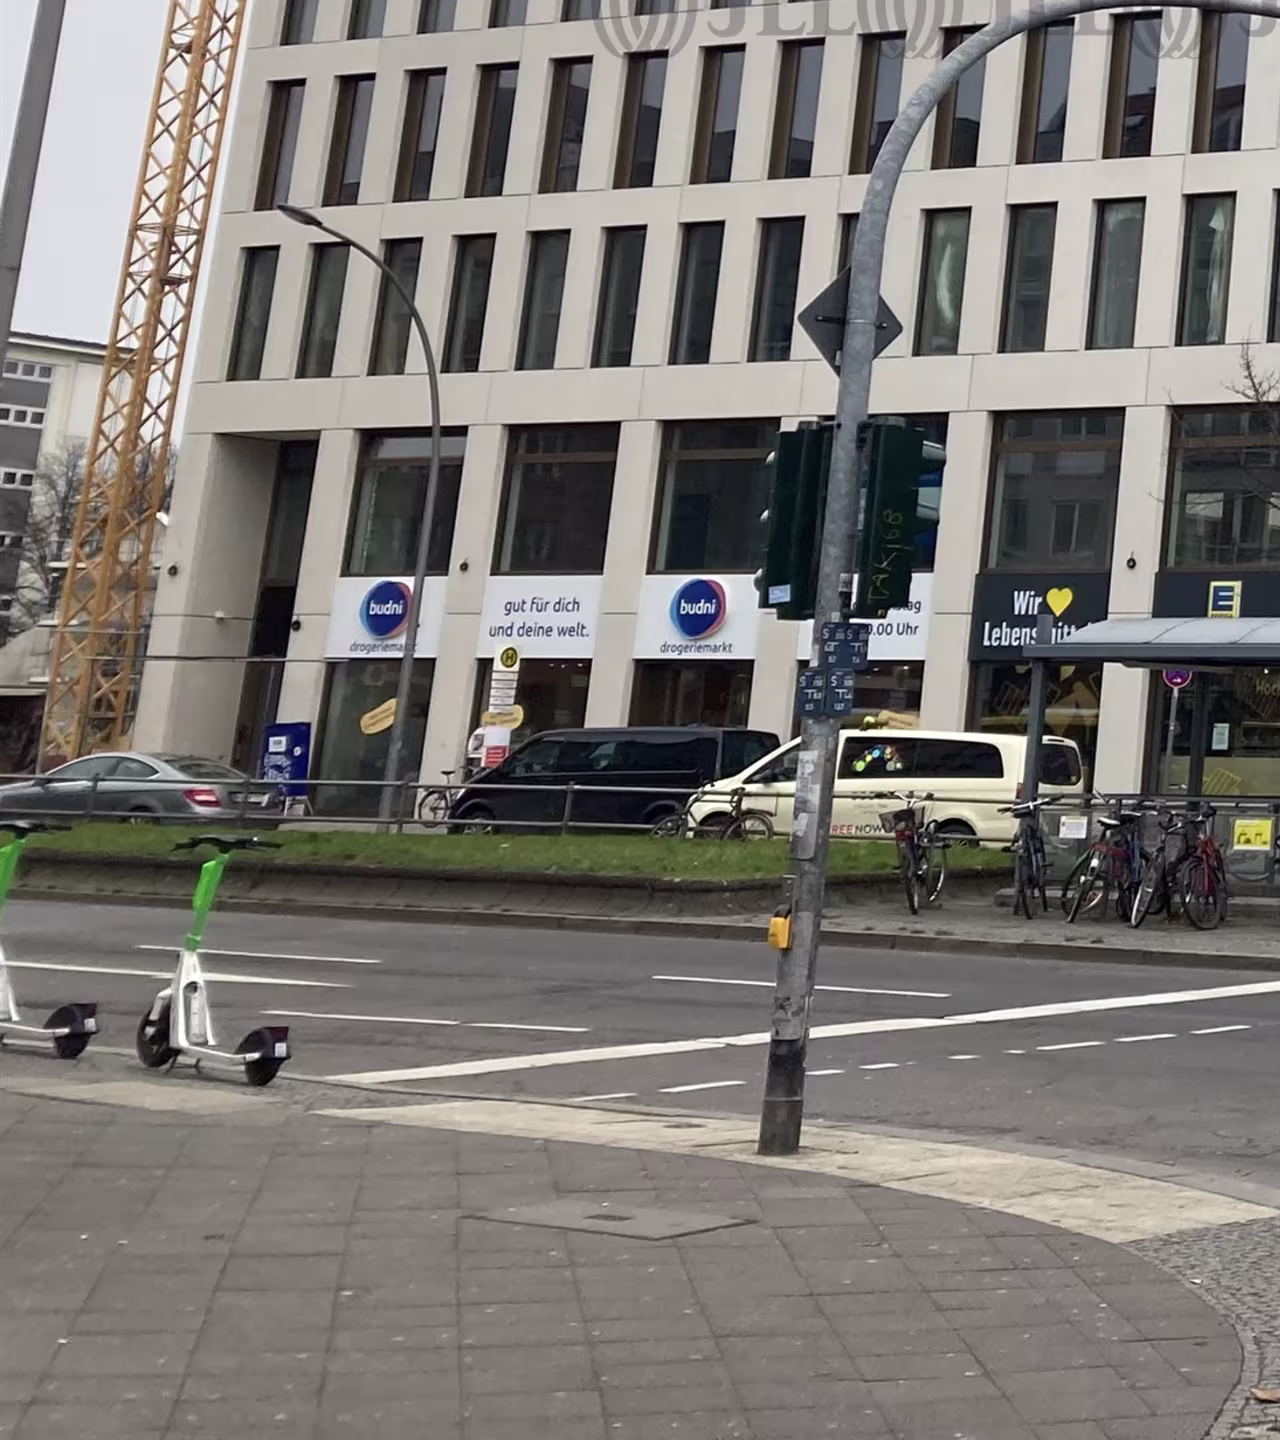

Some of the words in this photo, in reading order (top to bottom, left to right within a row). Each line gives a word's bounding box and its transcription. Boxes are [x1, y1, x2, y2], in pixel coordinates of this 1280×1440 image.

[369, 599, 403, 615] budni
[504, 598, 526, 616] gut
[529, 596, 550, 612] für
[553, 597, 580, 613] dich
[680, 599, 716, 614] budni
[1013, 590, 1043, 615] Wir
[489, 621, 513, 637] und
[517, 621, 553, 637] deine
[557, 621, 589, 637] welt.
[897, 622, 919, 636] Uhr
[660, 641, 733, 656] drogeriemarkt
